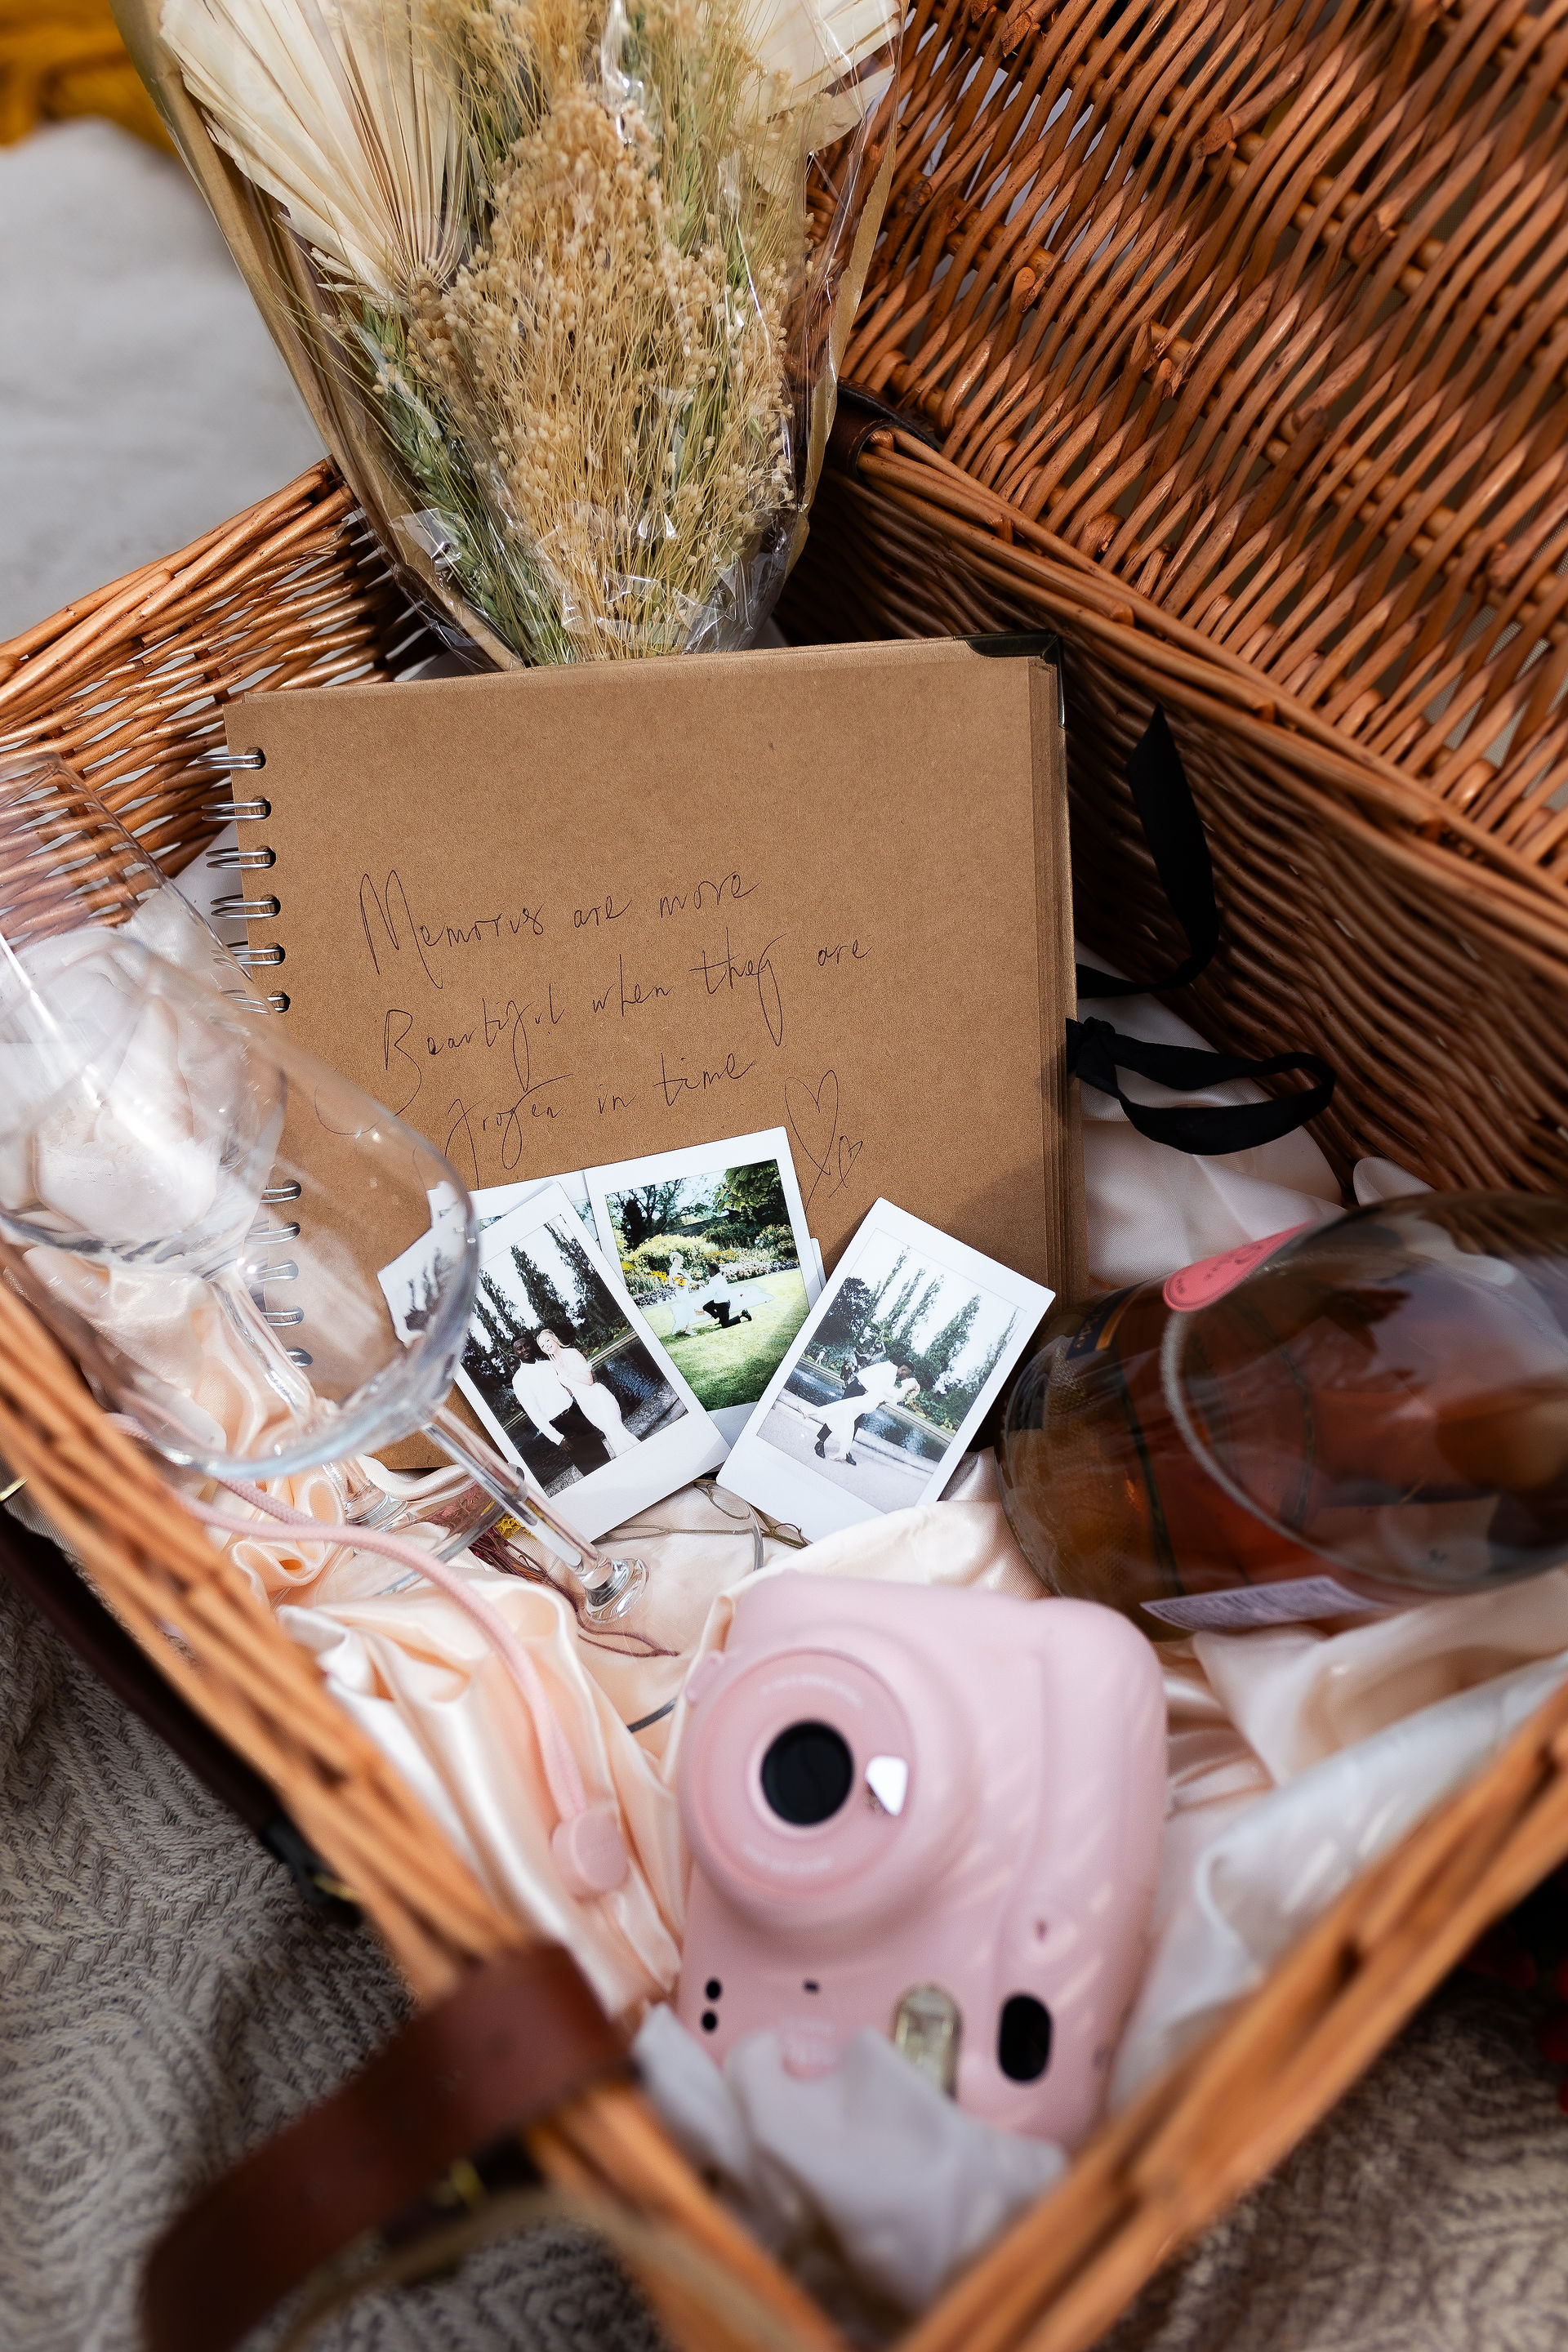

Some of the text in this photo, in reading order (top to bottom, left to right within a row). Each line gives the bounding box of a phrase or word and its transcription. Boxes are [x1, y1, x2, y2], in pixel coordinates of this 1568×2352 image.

[573, 895, 632, 929] are
[659, 871, 763, 919] more
[383, 927, 872, 1119] Beautiful when they are
[599, 1084, 636, 1114] in
[655, 1053, 755, 1107] time
